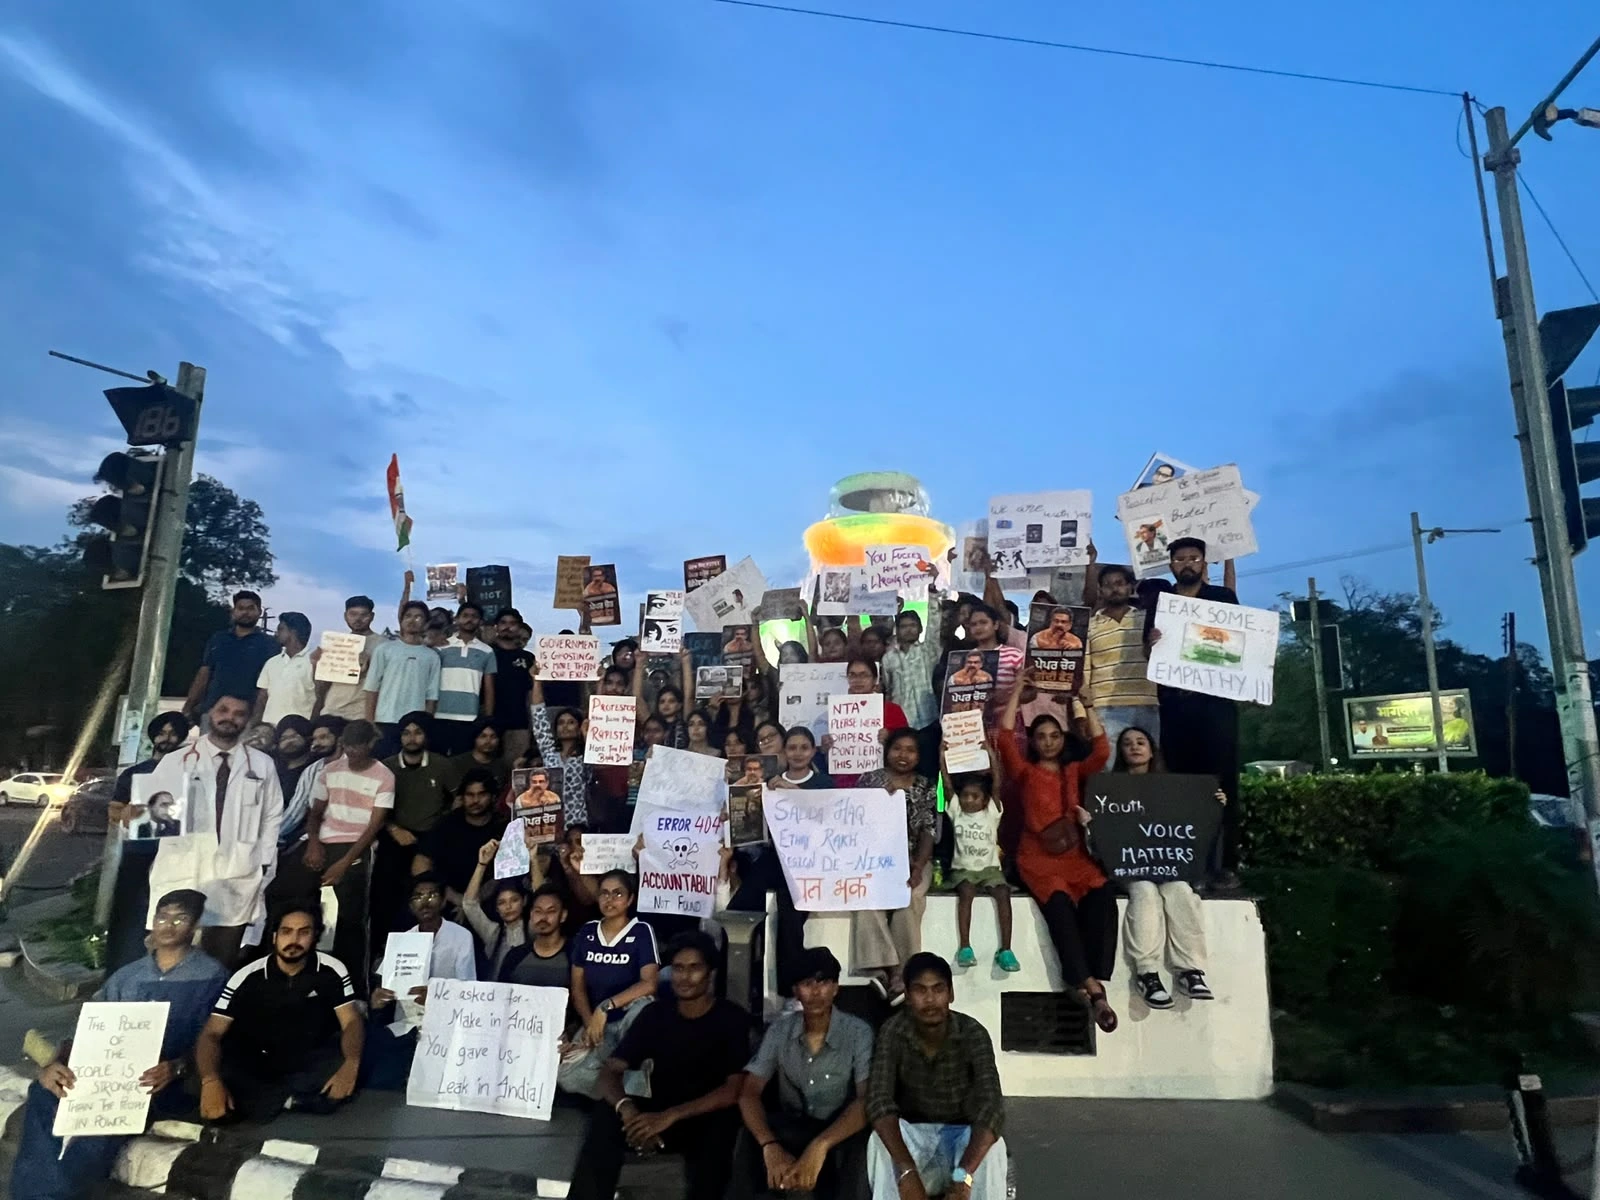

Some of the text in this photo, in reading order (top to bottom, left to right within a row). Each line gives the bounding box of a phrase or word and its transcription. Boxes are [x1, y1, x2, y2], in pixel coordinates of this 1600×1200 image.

[1156, 598, 1201, 620] LEAK
[539, 637, 599, 650] GOVERNMENT
[540, 651, 548, 660] IS
[1034, 657, 1076, 671] ਪੇਪਰ ਚੋਰ
[1155, 662, 1248, 696] EMPATHY
[832, 702, 861, 715] NTA
[832, 760, 853, 770] THIS
[657, 817, 692, 832] ERROR
[694, 815, 722, 834] 404
[820, 828, 858, 854] RAKH
[1121, 847, 1194, 864] MATTERS
[1152, 866, 1179, 877] 2026
[586, 951, 630, 965] DGOLD
[434, 982, 450, 1001] We
[459, 987, 495, 1002] asked
[447, 1008, 483, 1029] Make
[490, 1012, 501, 1028] in
[109, 1035, 126, 1047] OF
[424, 1034, 448, 1058] You
[455, 1046, 489, 1067] gave
[121, 1062, 136, 1079] IS
[437, 1073, 468, 1095] Leak
[477, 1077, 490, 1096] in
